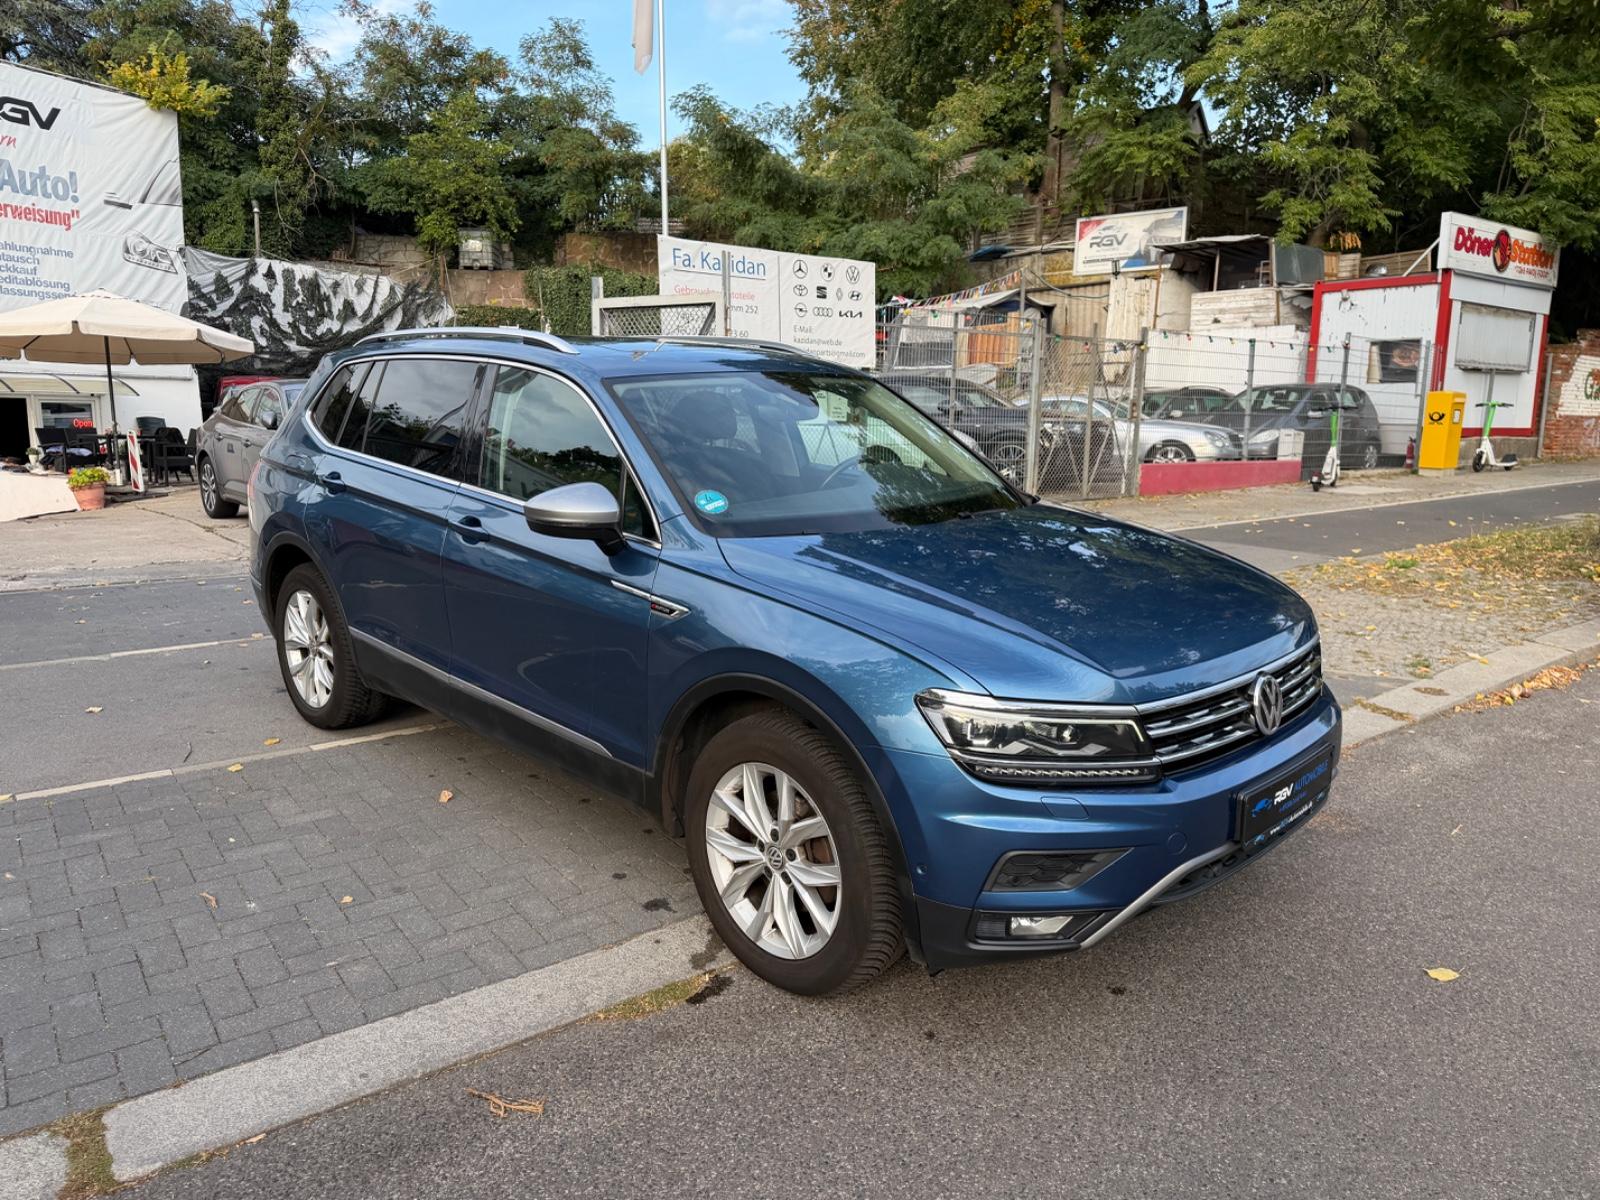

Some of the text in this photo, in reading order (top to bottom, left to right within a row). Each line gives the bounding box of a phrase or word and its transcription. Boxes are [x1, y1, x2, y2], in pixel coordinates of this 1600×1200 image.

[0, 96, 61, 131] GV
[0, 158, 80, 204] Auto!
[1089, 232, 1129, 249] RGV
[1454, 225, 1495, 257] Döner
[0, 251, 40, 265] tausch
[672, 247, 766, 276] Fa. Kaidan
[745, 304, 759, 314] 252
[73, 417, 94, 429] Open
[1273, 782, 1294, 806] RGV
